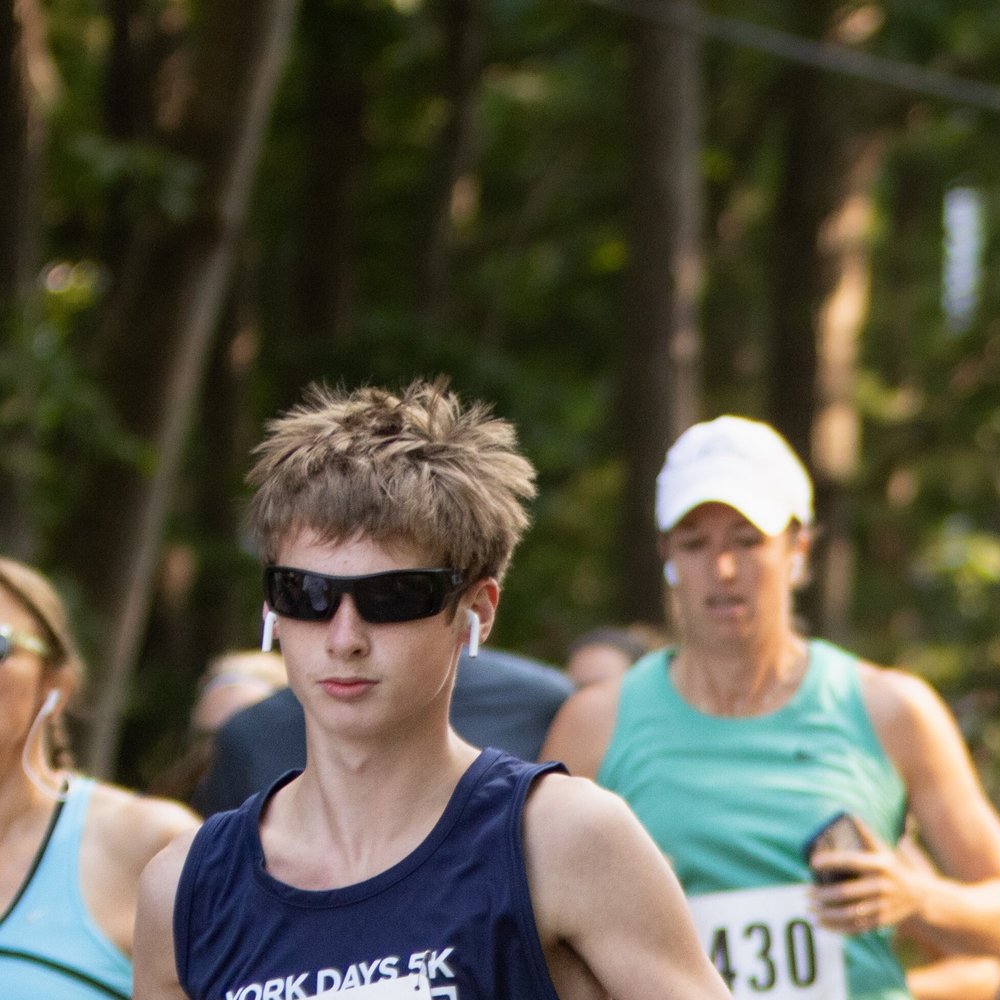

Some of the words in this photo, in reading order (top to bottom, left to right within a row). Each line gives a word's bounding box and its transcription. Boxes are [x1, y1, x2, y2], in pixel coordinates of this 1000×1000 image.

[316, 957, 400, 996] DAYS
[407, 948, 456, 980] 5K
[708, 918, 817, 992] 430
